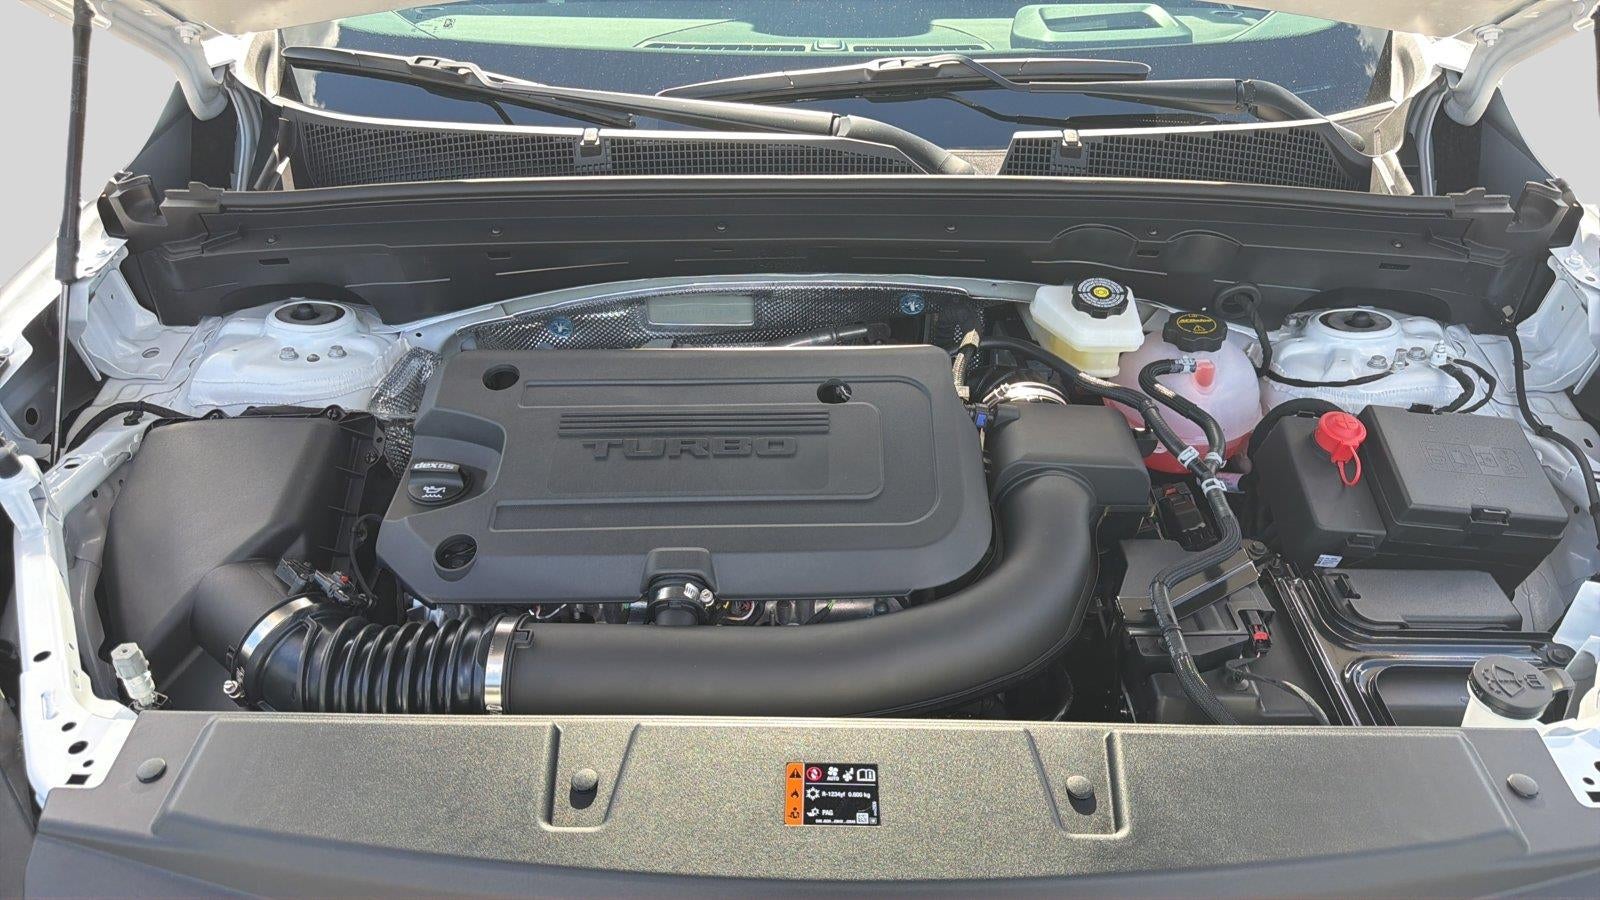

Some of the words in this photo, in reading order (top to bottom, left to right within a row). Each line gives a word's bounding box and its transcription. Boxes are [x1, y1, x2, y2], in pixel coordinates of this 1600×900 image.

[581, 438, 798, 460] TURBO
[413, 461, 455, 470] dexos
[821, 790, 846, 798] R-1234yf
